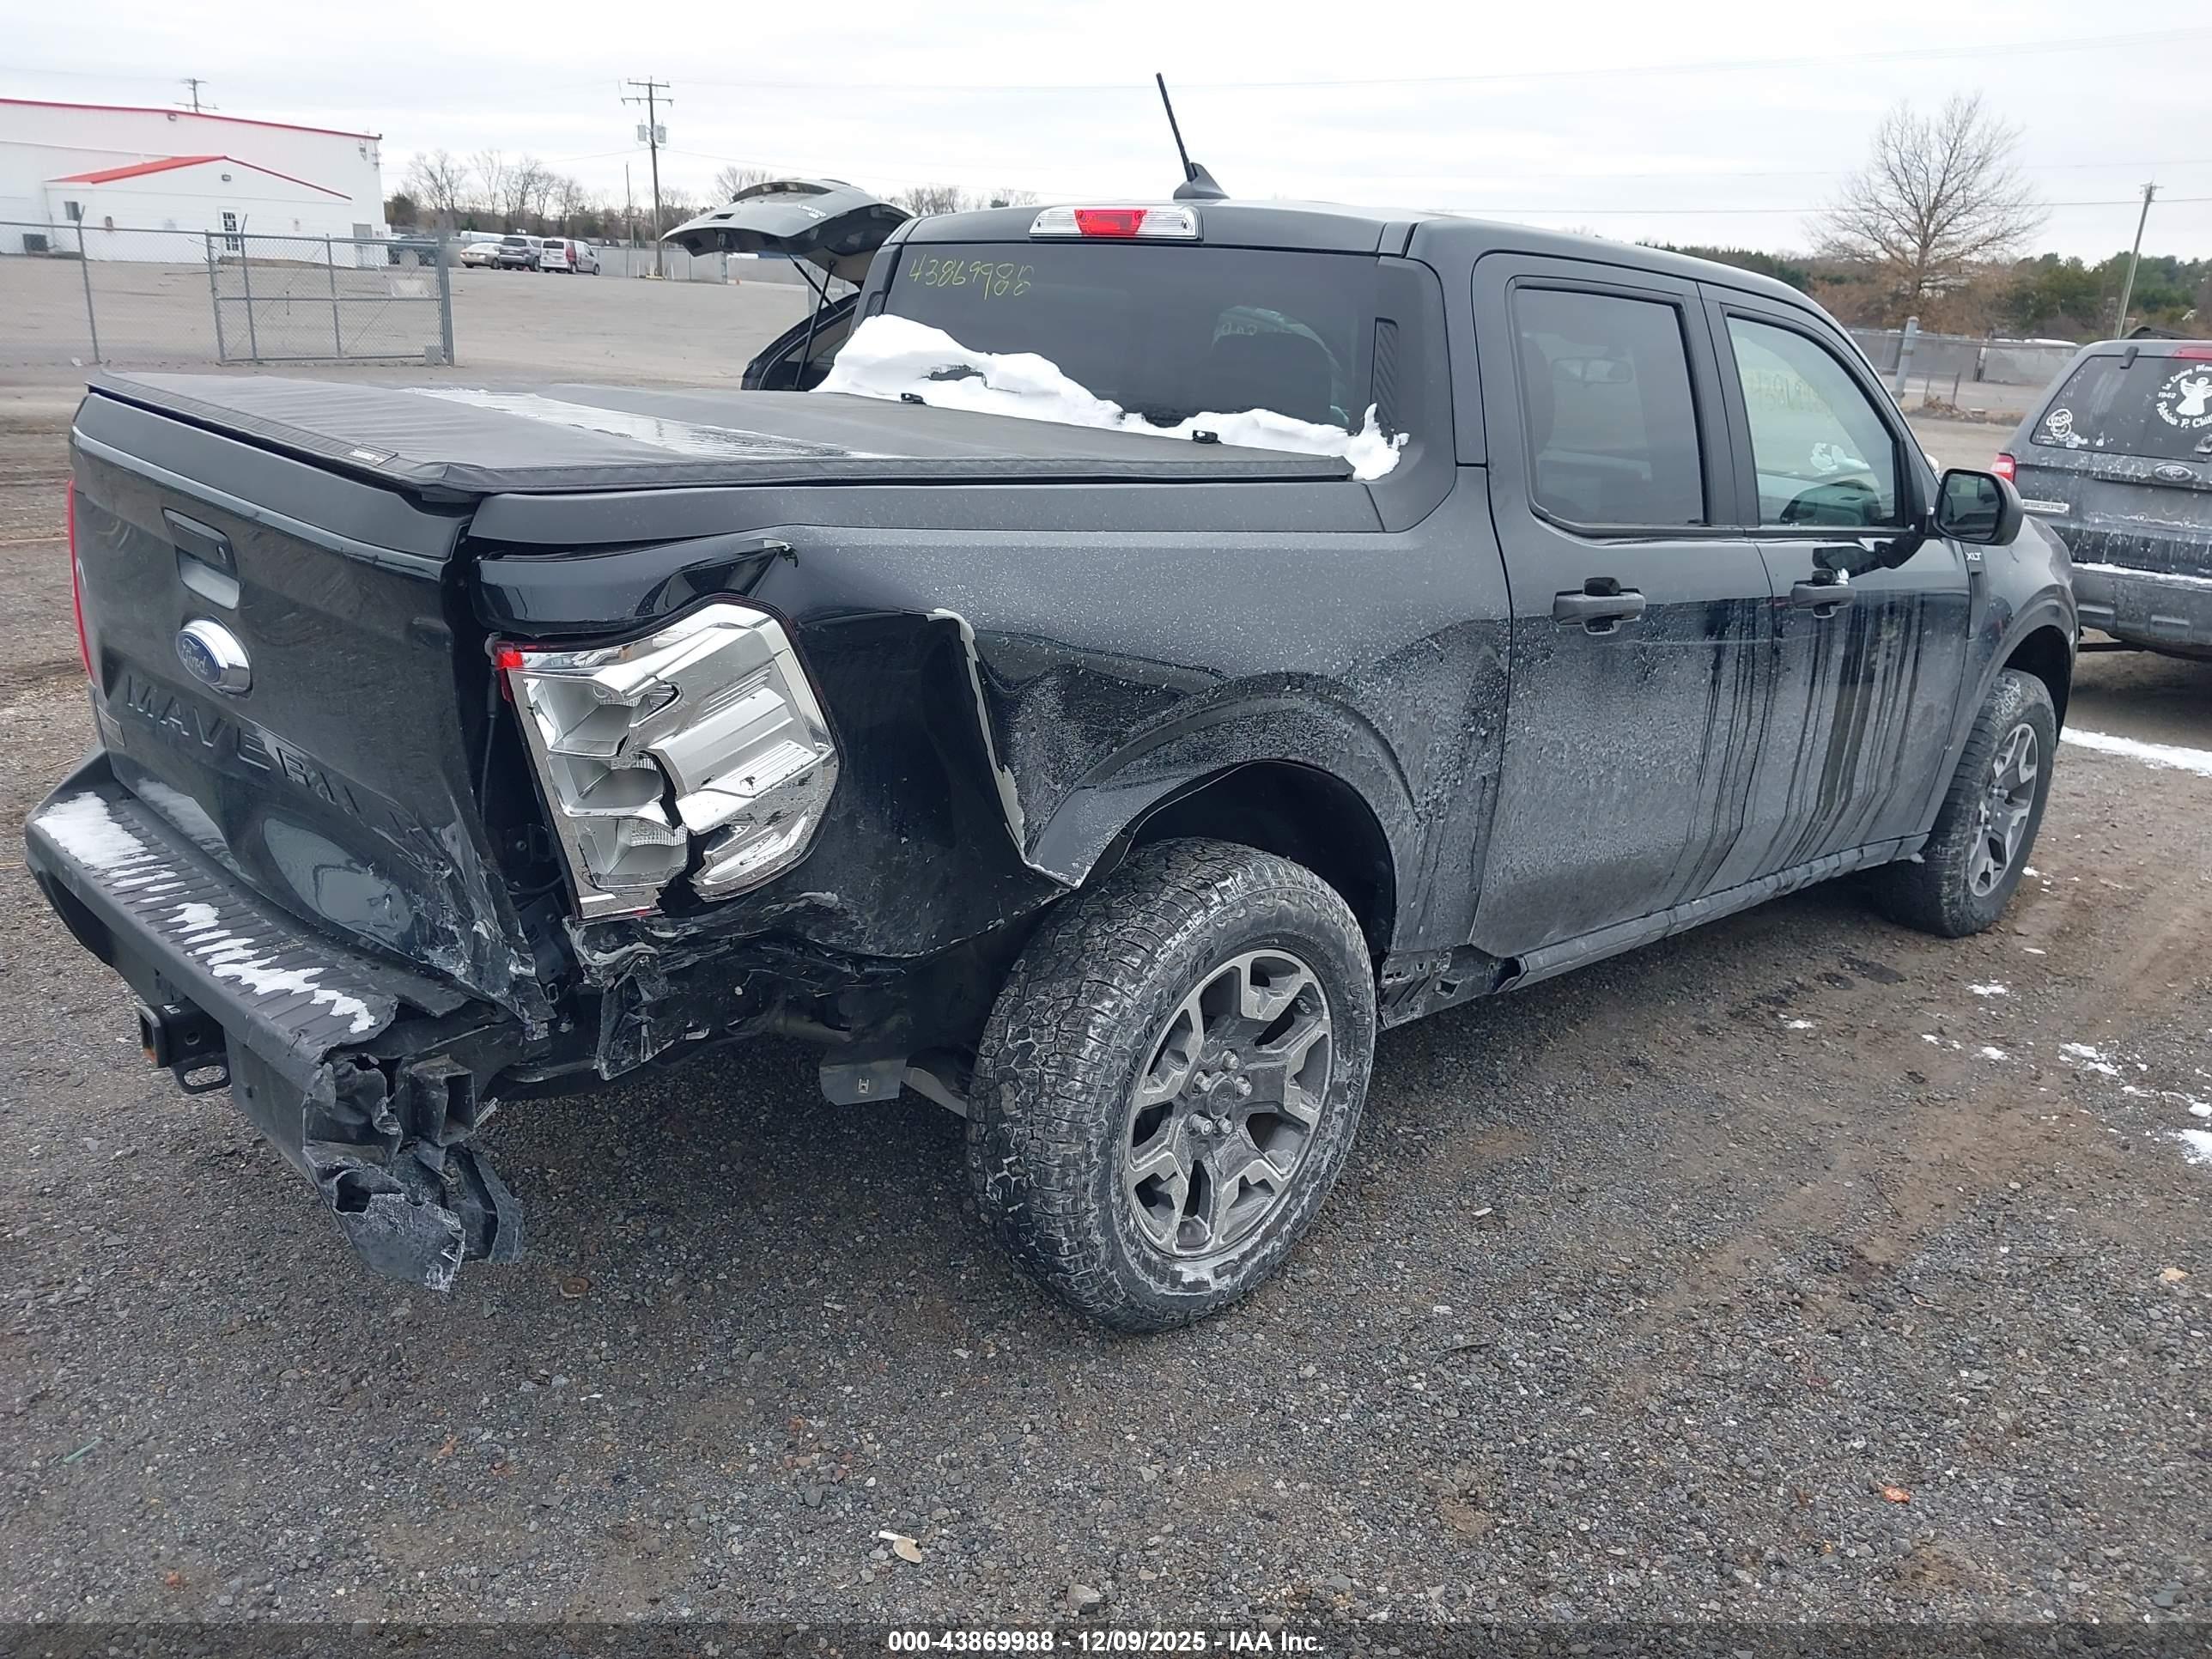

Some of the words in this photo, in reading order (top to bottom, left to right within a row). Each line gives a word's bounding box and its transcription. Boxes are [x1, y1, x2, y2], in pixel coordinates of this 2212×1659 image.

[908, 254, 1035, 301] 43869988
[1966, 552, 1981, 561] XLT
[181, 638, 208, 675] Ford
